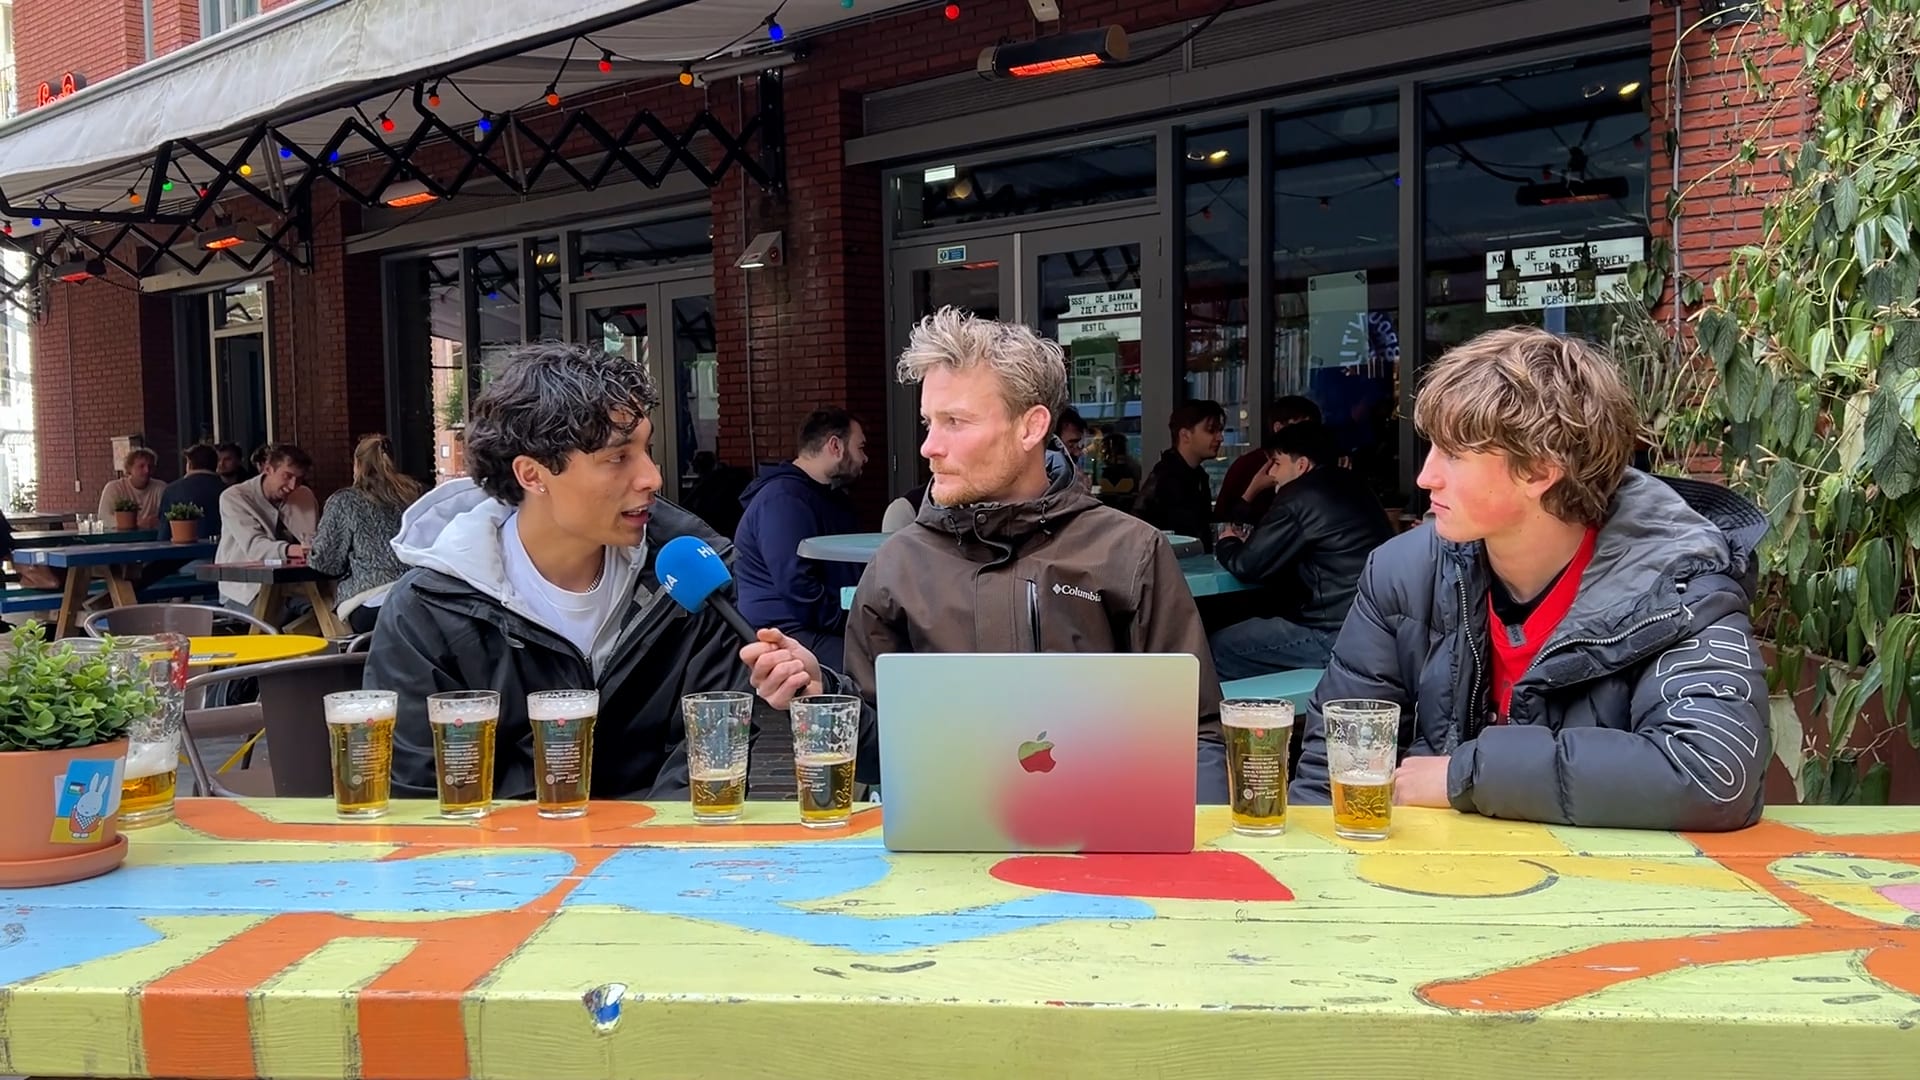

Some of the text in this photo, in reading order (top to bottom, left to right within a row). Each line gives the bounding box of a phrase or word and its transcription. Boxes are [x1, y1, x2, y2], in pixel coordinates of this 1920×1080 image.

[1525, 251, 1536, 261] JE
[1549, 245, 1598, 258] GEZEG
[1095, 295, 1104, 303] DE
[1108, 293, 1133, 302] BARMAN
[1081, 302, 1138, 315] ZIET JE ZITTEN
